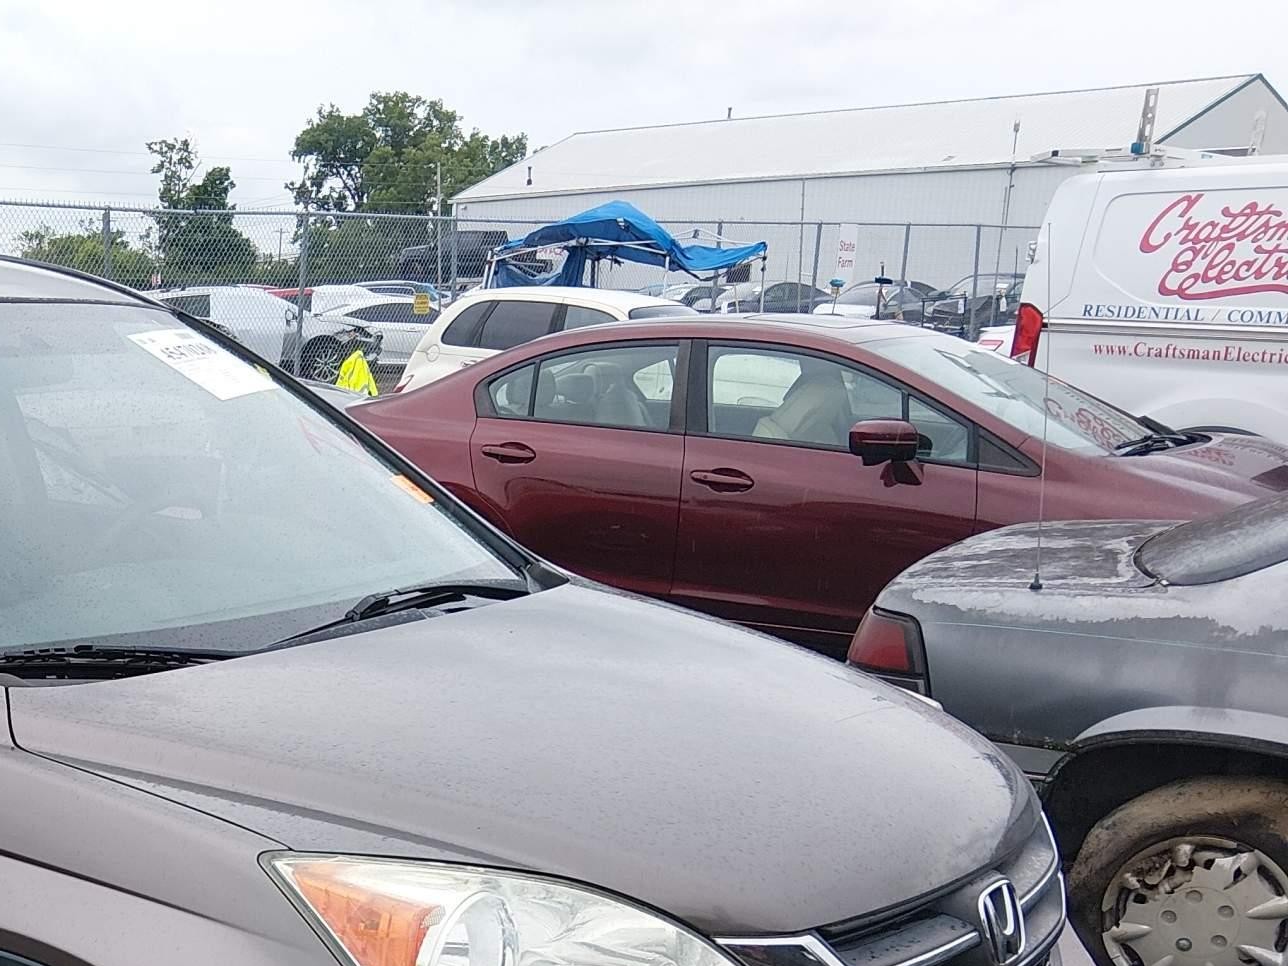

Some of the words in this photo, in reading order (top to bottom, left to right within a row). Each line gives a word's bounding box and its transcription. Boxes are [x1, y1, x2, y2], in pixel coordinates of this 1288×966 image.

[839, 240, 856, 252] State
[838, 256, 853, 268] Farm
[1082, 303, 1205, 321] RESIDENTIAL
